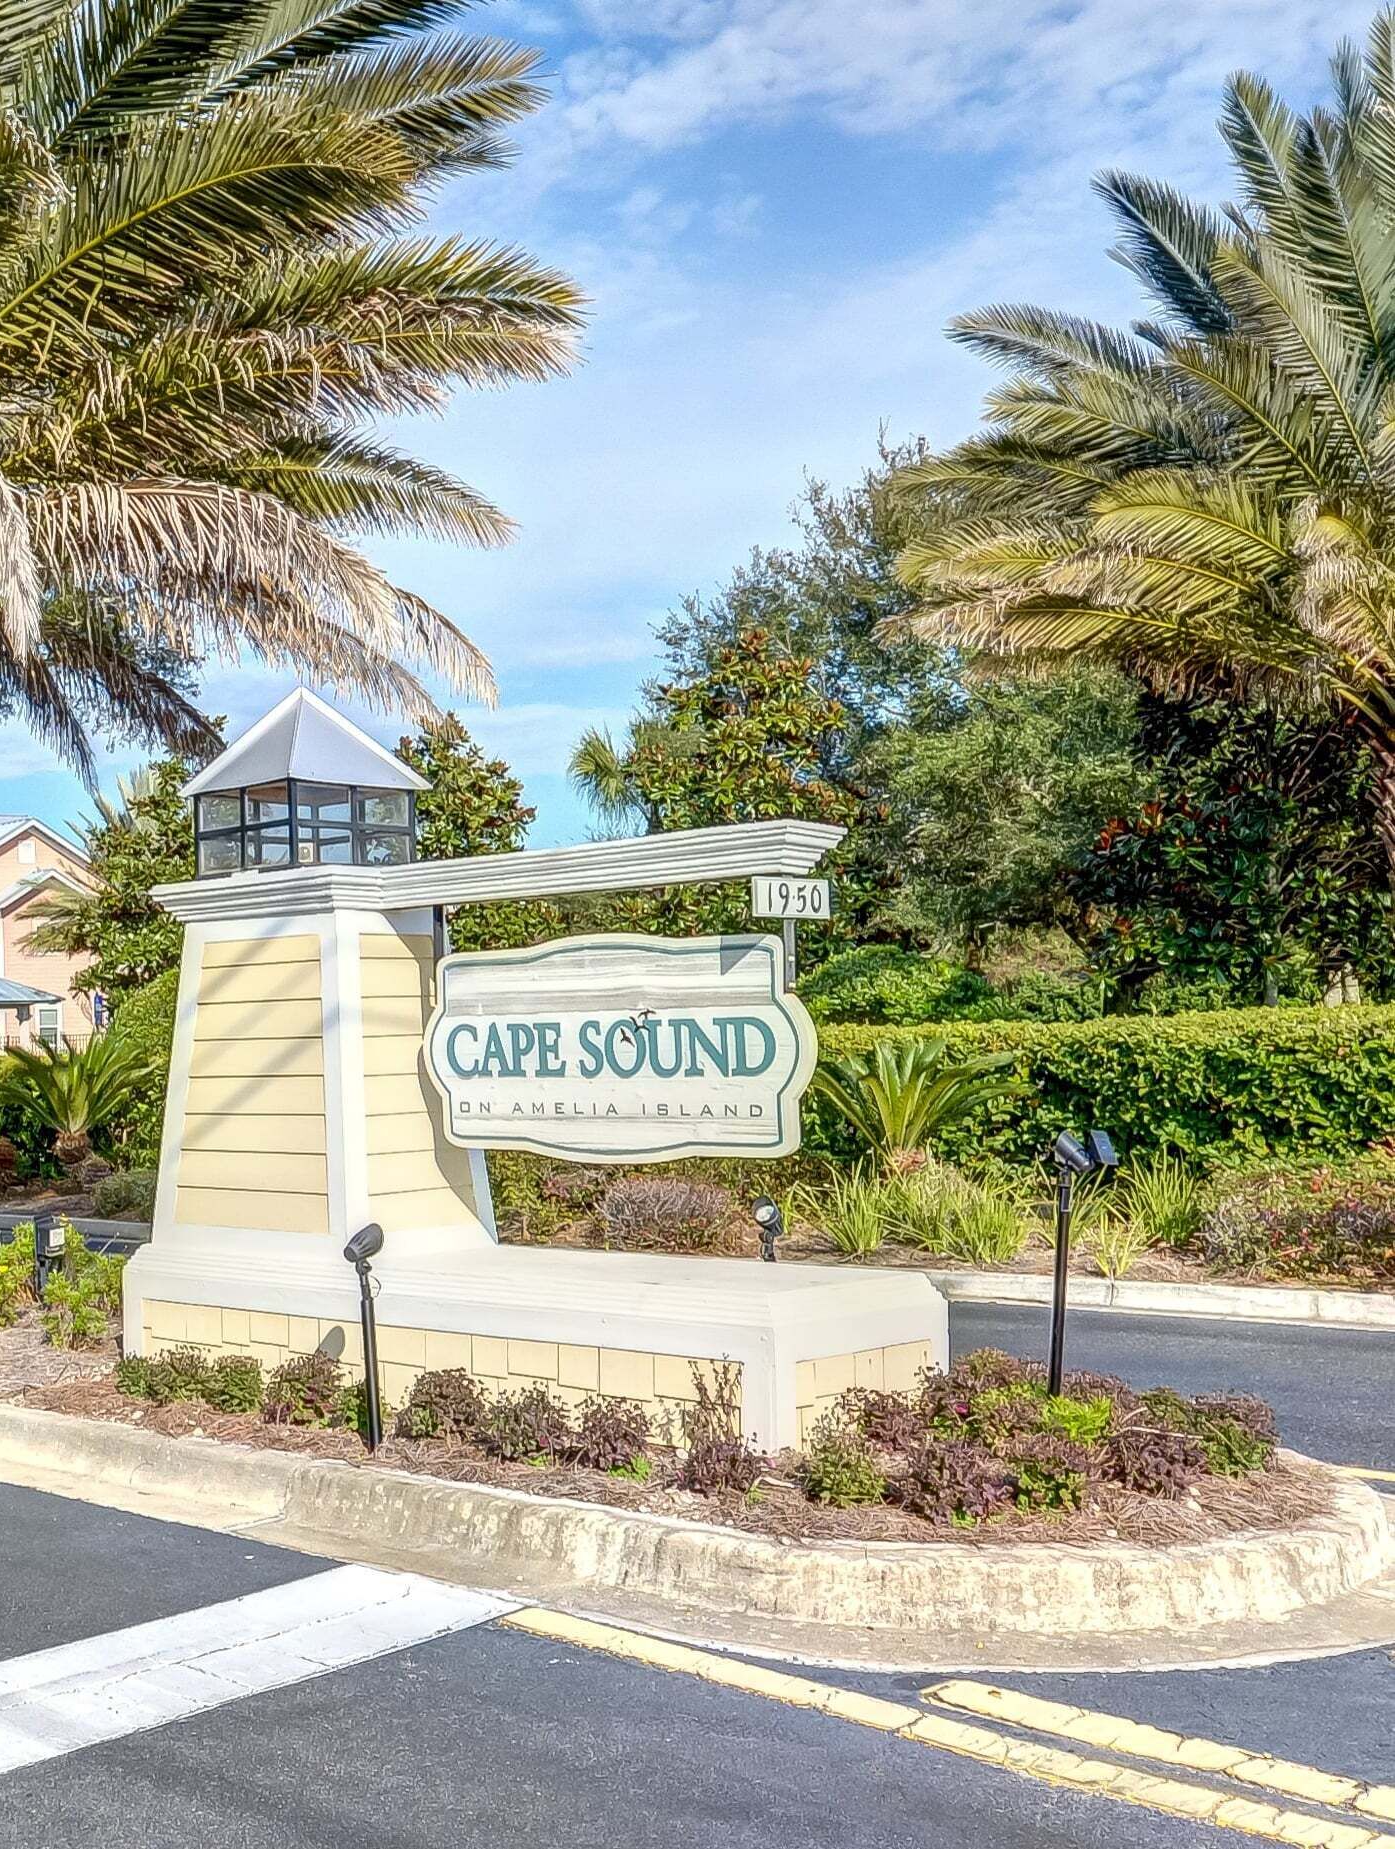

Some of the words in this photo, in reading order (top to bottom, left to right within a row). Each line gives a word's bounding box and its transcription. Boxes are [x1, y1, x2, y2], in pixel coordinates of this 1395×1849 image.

[768, 882, 822, 915] 1950
[446, 1022, 567, 1079] CAPE
[578, 1016, 777, 1079] SOUND
[459, 1101, 491, 1114] ON
[511, 1102, 619, 1116] AMELIA
[642, 1103, 764, 1117] ISLAND
